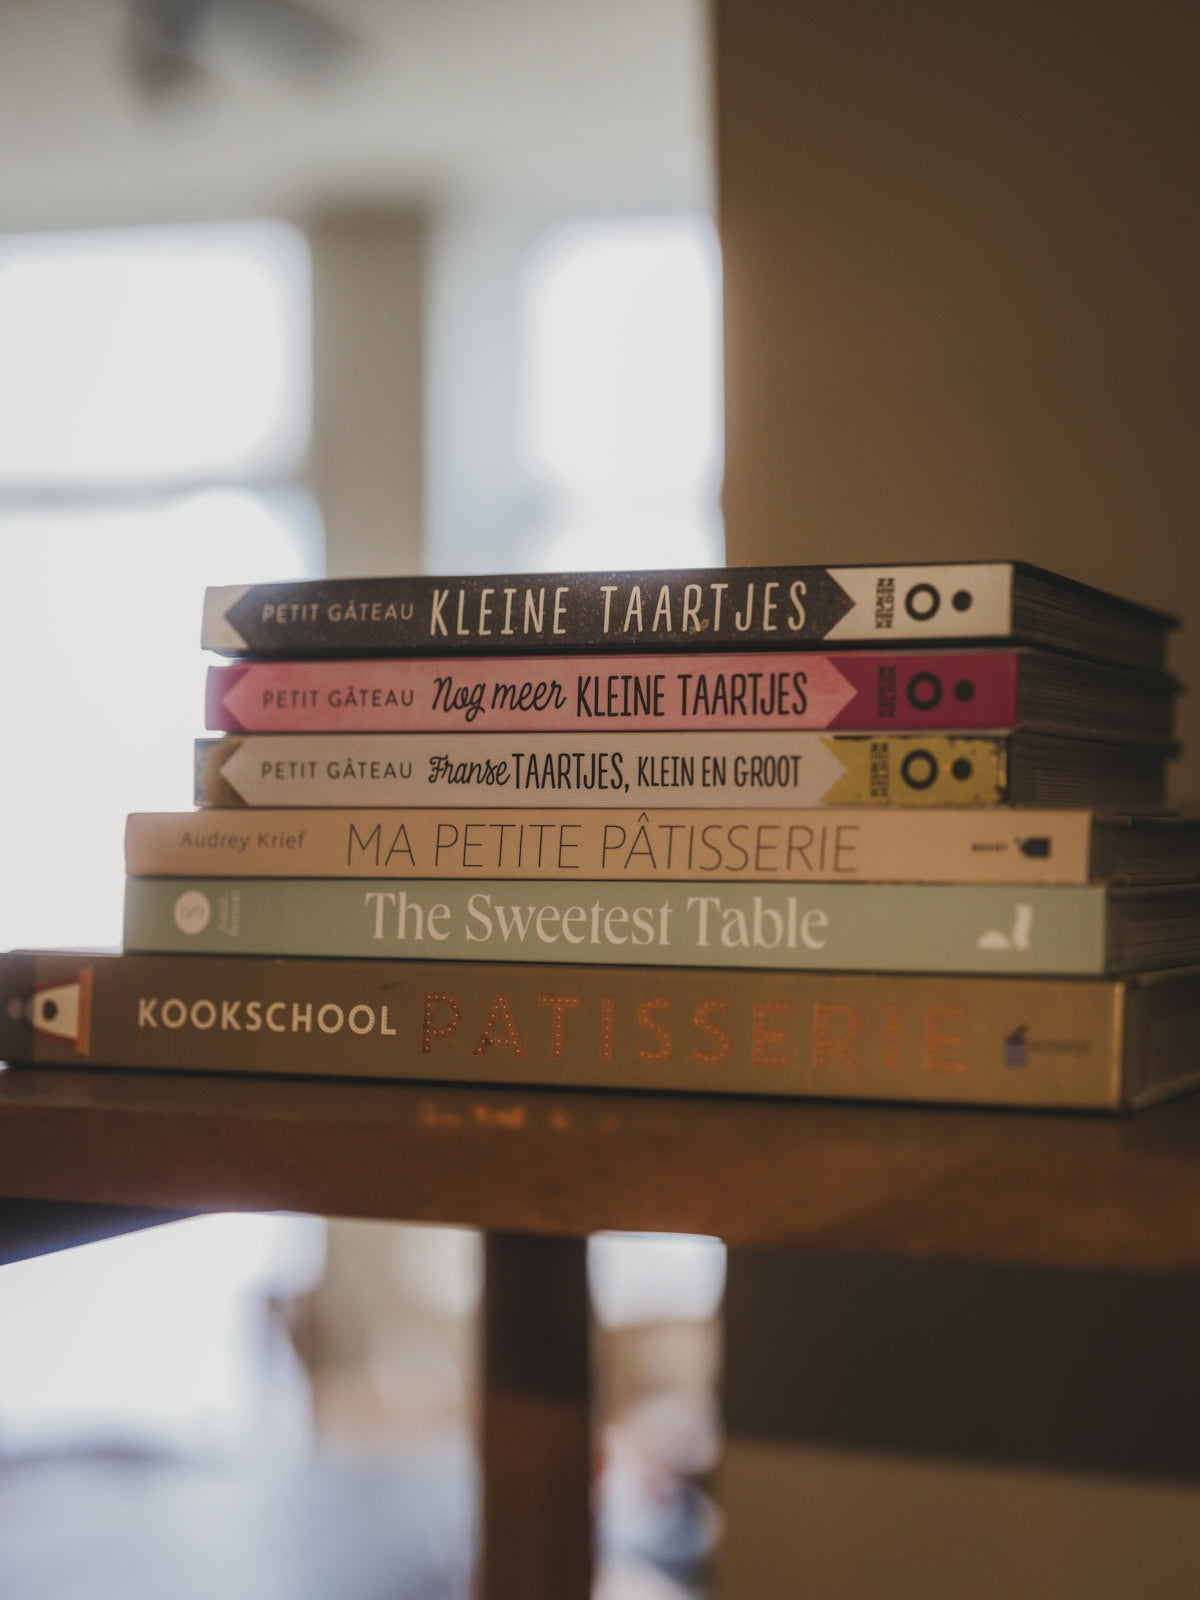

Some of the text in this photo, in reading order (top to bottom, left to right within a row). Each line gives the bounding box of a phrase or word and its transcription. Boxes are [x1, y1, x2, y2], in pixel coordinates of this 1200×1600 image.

[262, 599, 413, 623] PETIT GÂTEAU
[430, 581, 807, 636] KLEINE TAARTJES
[262, 686, 413, 708] PETIT GÂTEAU
[432, 672, 808, 722] Nog meer KLEINE TAARTJES
[261, 757, 412, 779] PETIT GÂTEAU
[428, 752, 802, 793] Franse TAARTJES, KLEIN EN GROOT
[179, 831, 305, 854] Audrey Krief
[347, 812, 861, 872] MA PETITE PÂTISSERIE
[365, 891, 830, 950] The Sweetest Table
[138, 990, 968, 1074] KOOKSCHOOL PATISSERIE
